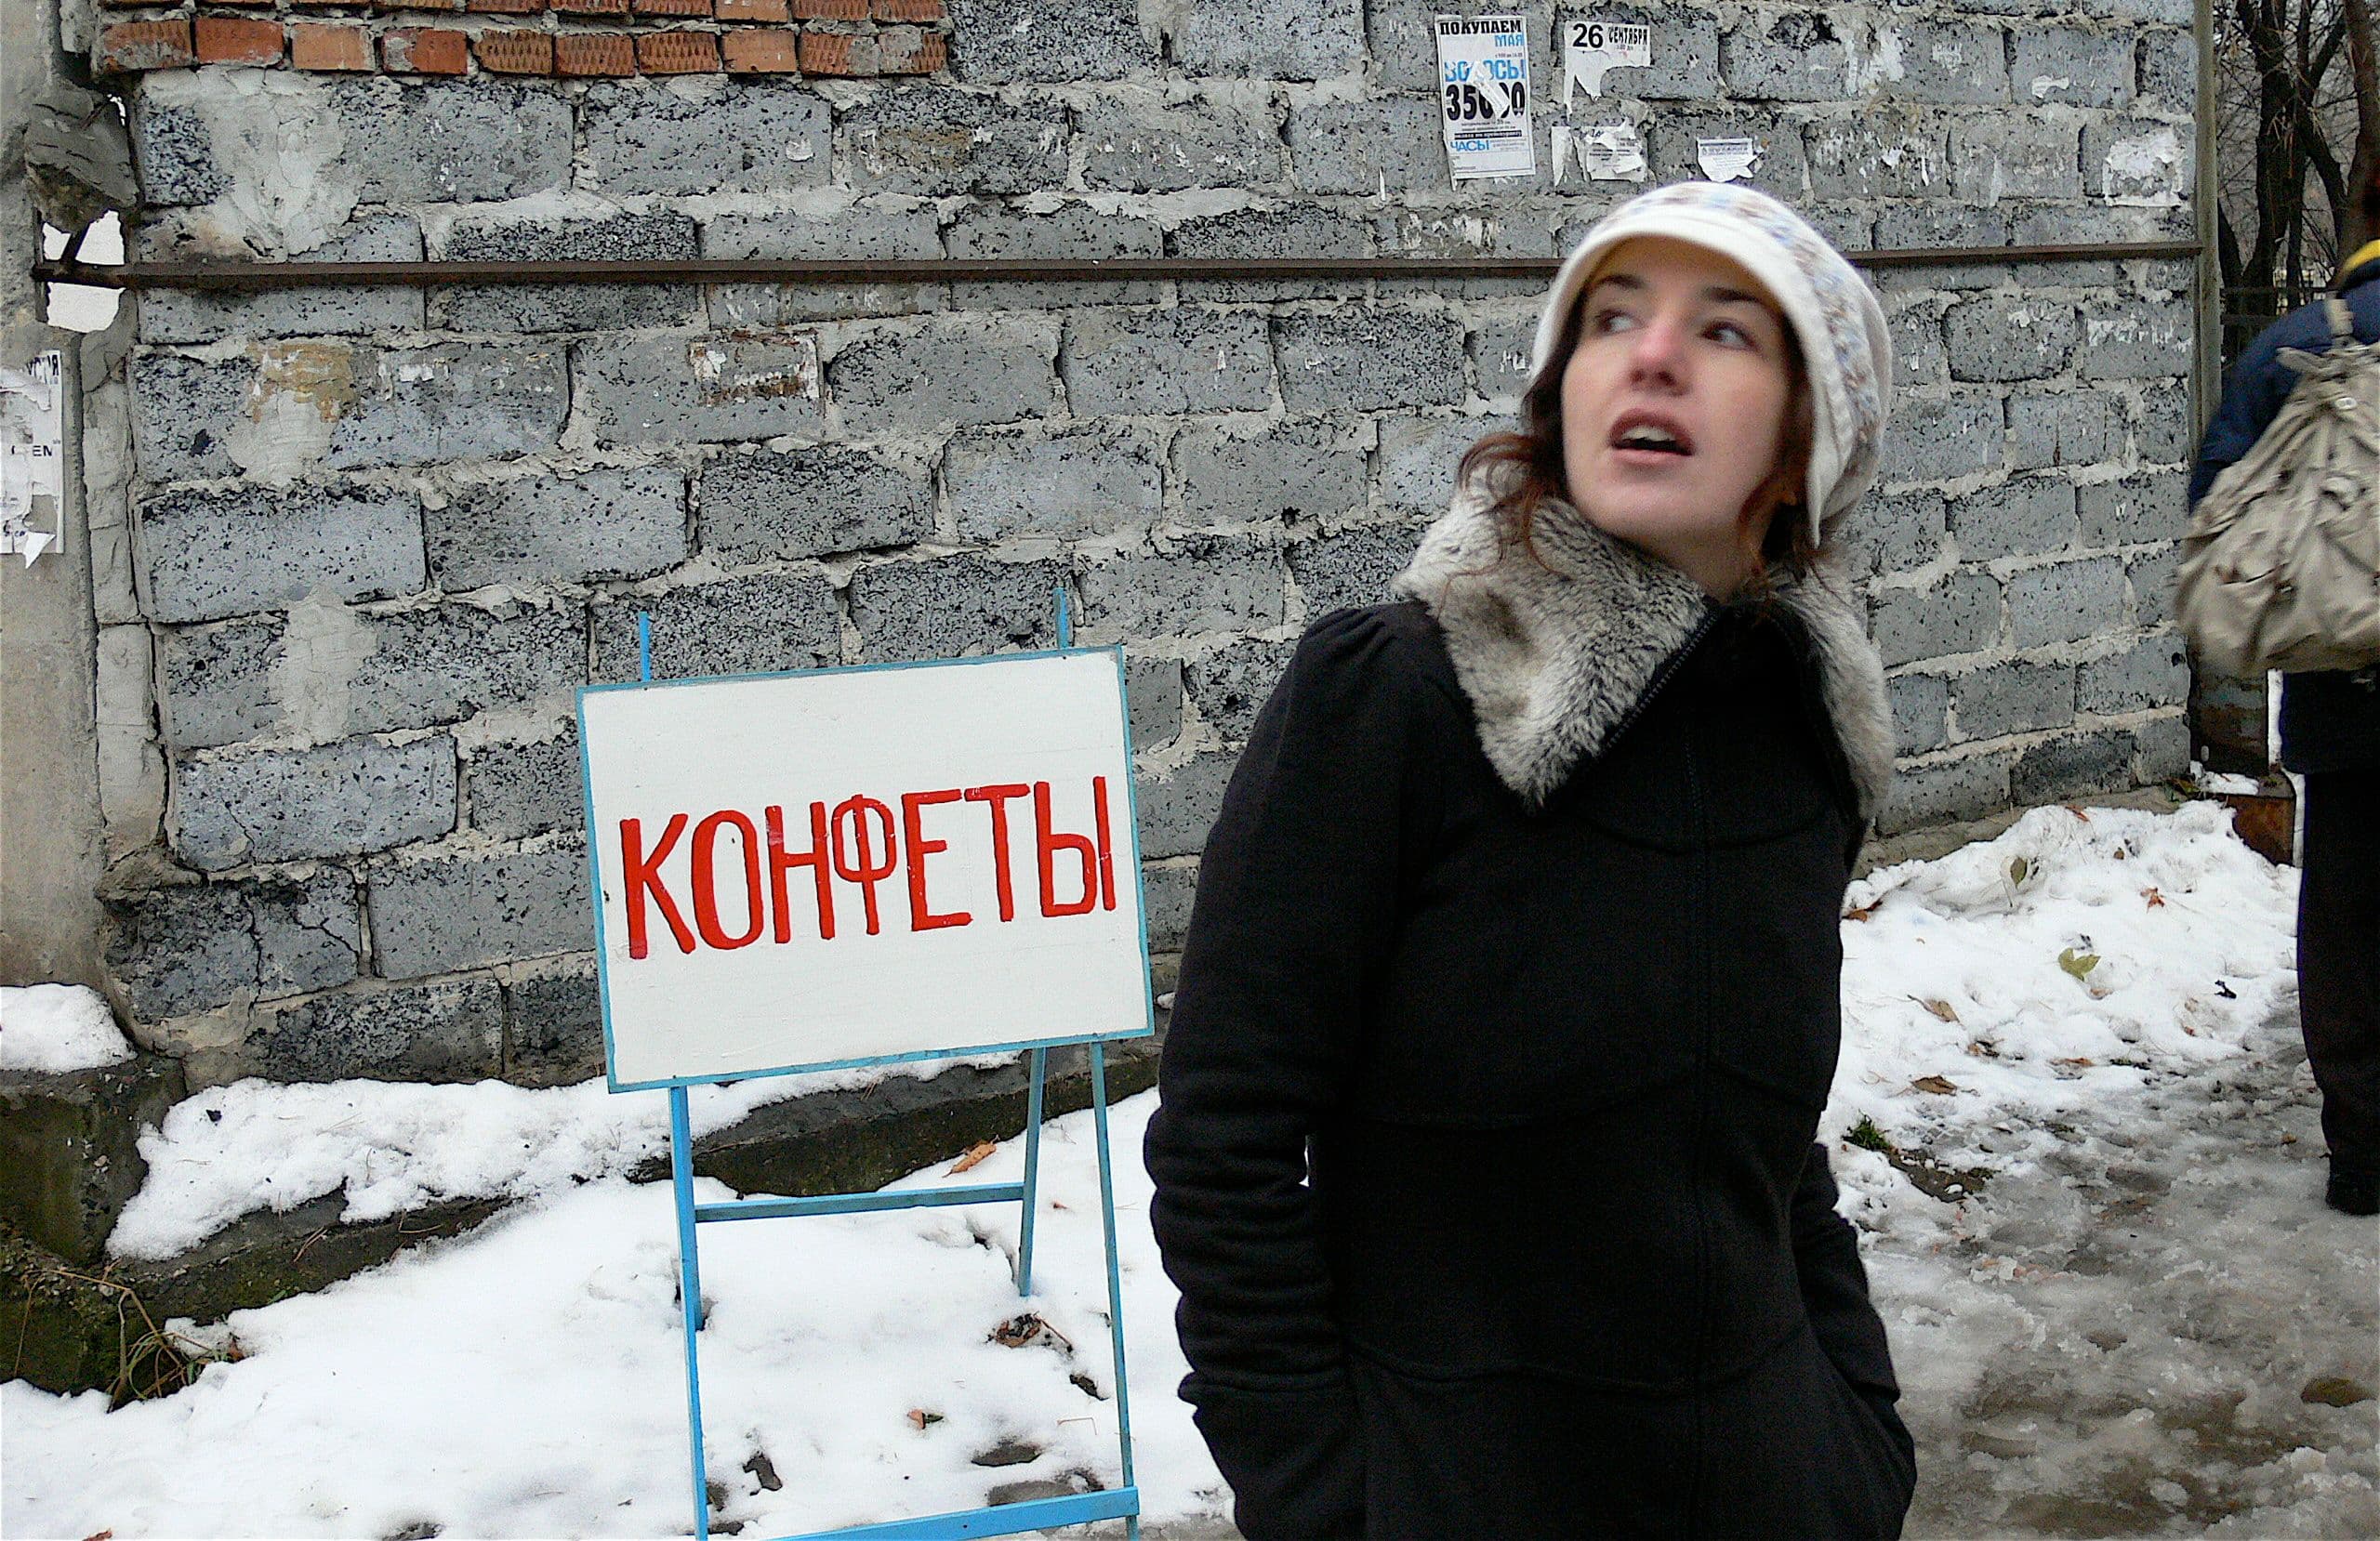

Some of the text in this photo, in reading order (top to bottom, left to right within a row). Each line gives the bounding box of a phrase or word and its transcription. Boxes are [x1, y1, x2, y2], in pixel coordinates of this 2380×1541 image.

[1440, 20, 1521, 35] ПОКУПАЕМ
[1573, 23, 1647, 48] 26 СЕНТЯБРЯ
[1444, 59, 1526, 82] ВООСЫ
[1450, 139, 1489, 151] ЧАСЫ
[620, 776, 1117, 959] КОНФЕТЫ
